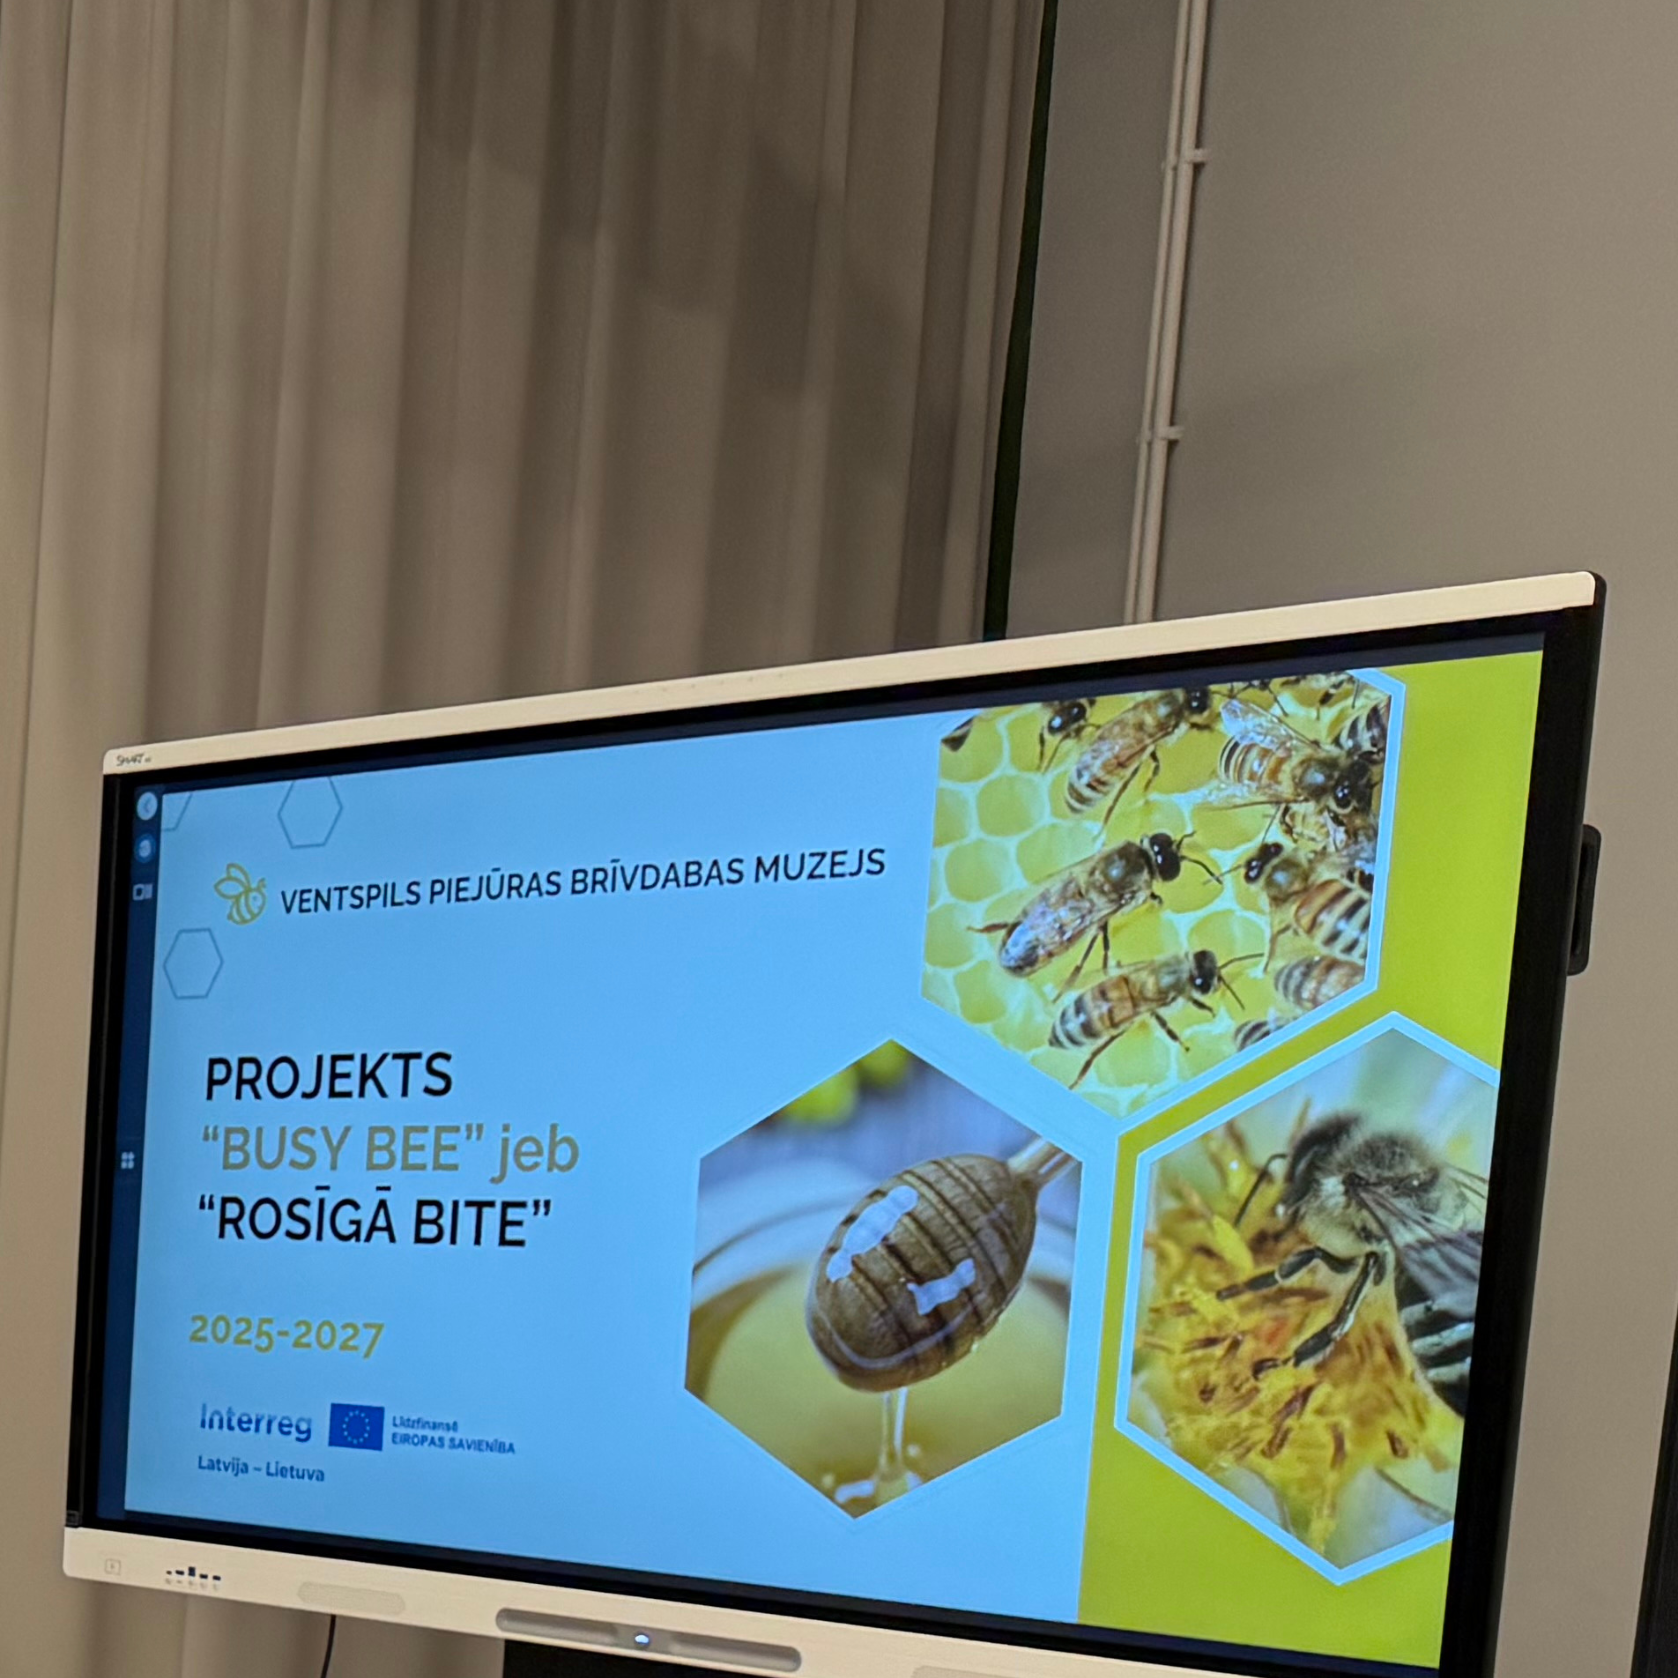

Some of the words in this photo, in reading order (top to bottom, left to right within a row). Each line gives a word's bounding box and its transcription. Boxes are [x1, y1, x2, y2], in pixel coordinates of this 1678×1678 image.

[281, 880, 421, 914] VENTSPILS
[429, 867, 562, 905] PIEJŪRAS
[570, 858, 744, 895] BRĪVDABAS
[754, 848, 886, 883] MUZEJS
[205, 1051, 454, 1101] PROJEKTS
[201, 1124, 352, 1171] “BUSY
[365, 1122, 485, 1172] BEE”
[489, 1122, 580, 1185] jeb
[198, 1184, 397, 1245] “ROSĪGĀ
[412, 1197, 552, 1247] BITE”
[189, 1314, 385, 1360] 2025-2027
[199, 1402, 313, 1443] Interreg
[391, 1432, 446, 1450] EIROPAS
[447, 1436, 517, 1455] SAVIENĪBA
[197, 1455, 249, 1477] Latvija
[265, 1461, 326, 1483] Lietuva
